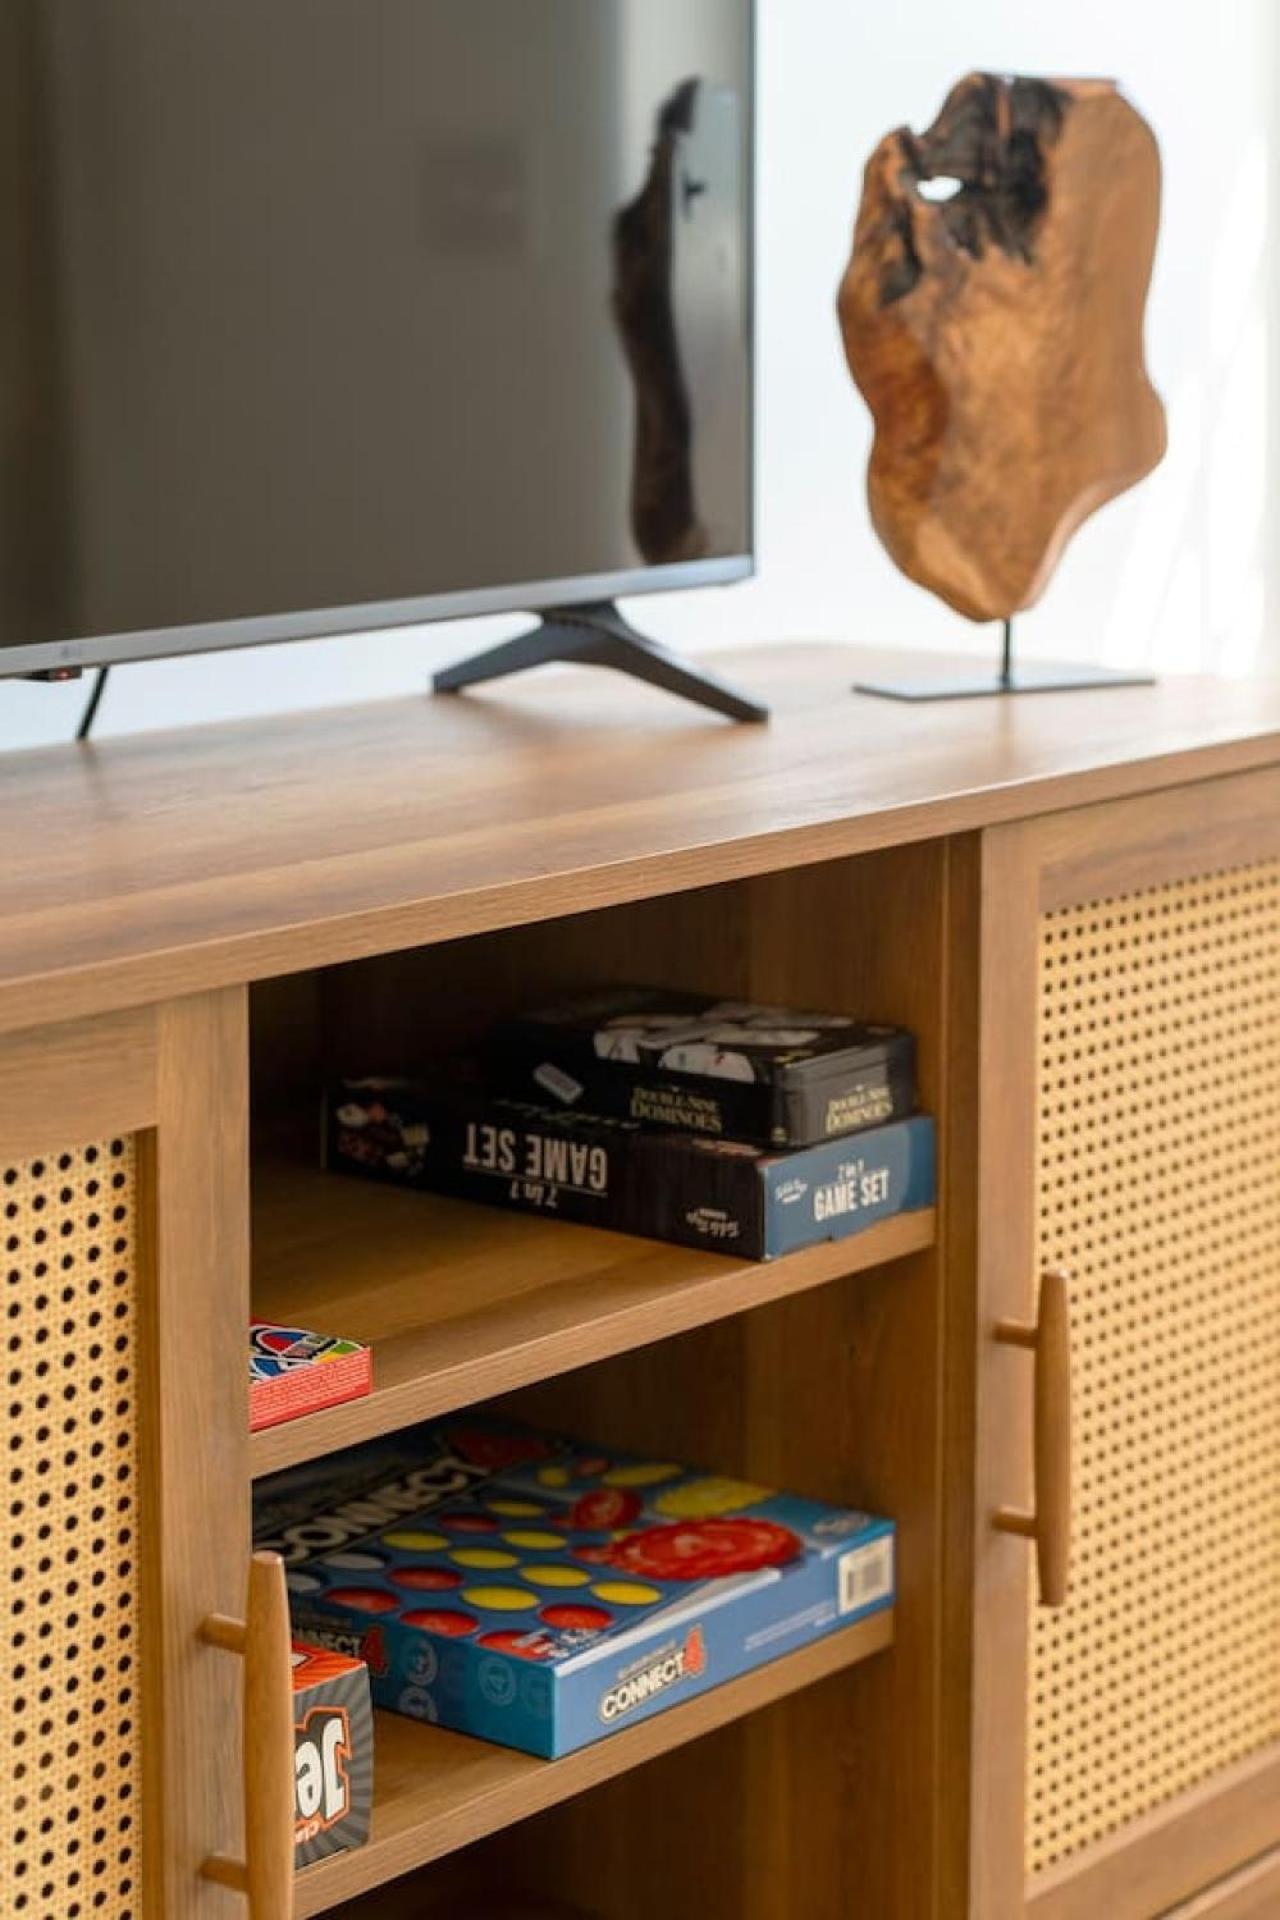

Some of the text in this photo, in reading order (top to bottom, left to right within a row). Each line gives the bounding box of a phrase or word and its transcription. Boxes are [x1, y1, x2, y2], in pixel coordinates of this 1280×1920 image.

[630, 1099, 722, 1132] DOMINOES
[826, 1099, 895, 1134] DOMINOES
[462, 1121, 608, 1190] GAME SET
[814, 1179, 858, 1222] GAME
[860, 1168, 890, 1207] SET
[602, 1651, 684, 1719] CONNECT
[295, 1717, 345, 1820] Je
